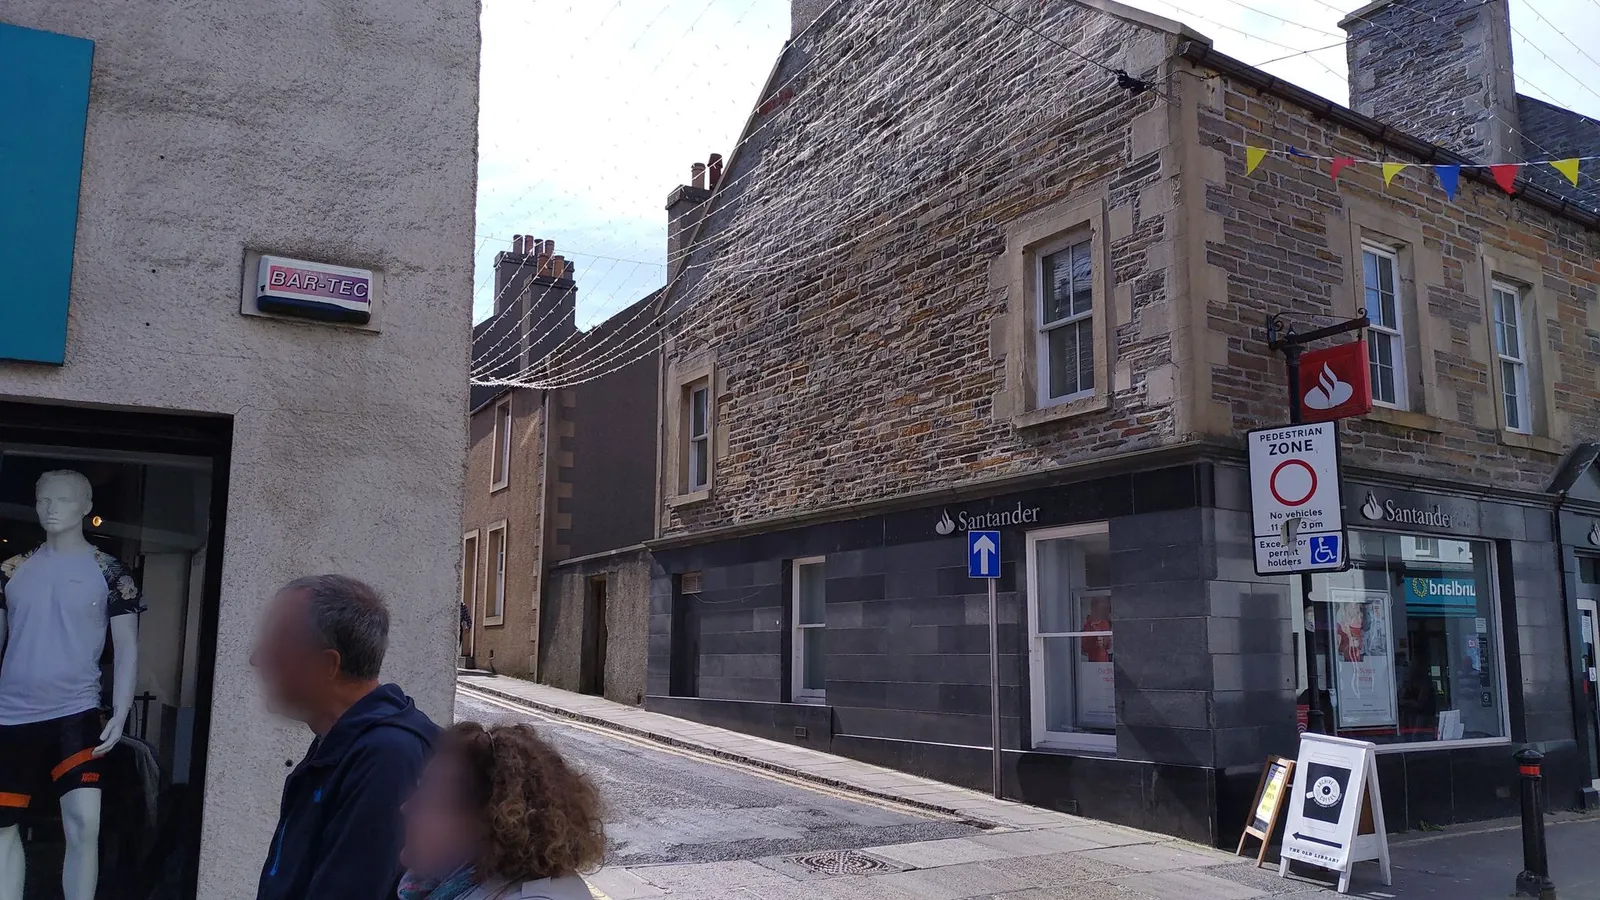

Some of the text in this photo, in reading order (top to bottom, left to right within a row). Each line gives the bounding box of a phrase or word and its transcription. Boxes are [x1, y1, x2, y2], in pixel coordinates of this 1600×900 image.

[271, 270, 368, 297] BAR-TEC
[1260, 427, 1322, 442] PEDESTRIAN
[1269, 439, 1313, 456] ZONE
[958, 501, 1040, 531] Santander
[1270, 509, 1323, 520] No vehicles
[1386, 499, 1455, 528] Santander
[1270, 523, 1279, 532] 11
[1301, 521, 1308, 529] 3
[1309, 521, 1323, 530] pm
[1260, 539, 1290, 549] Exce
[1268, 559, 1302, 567] holders
